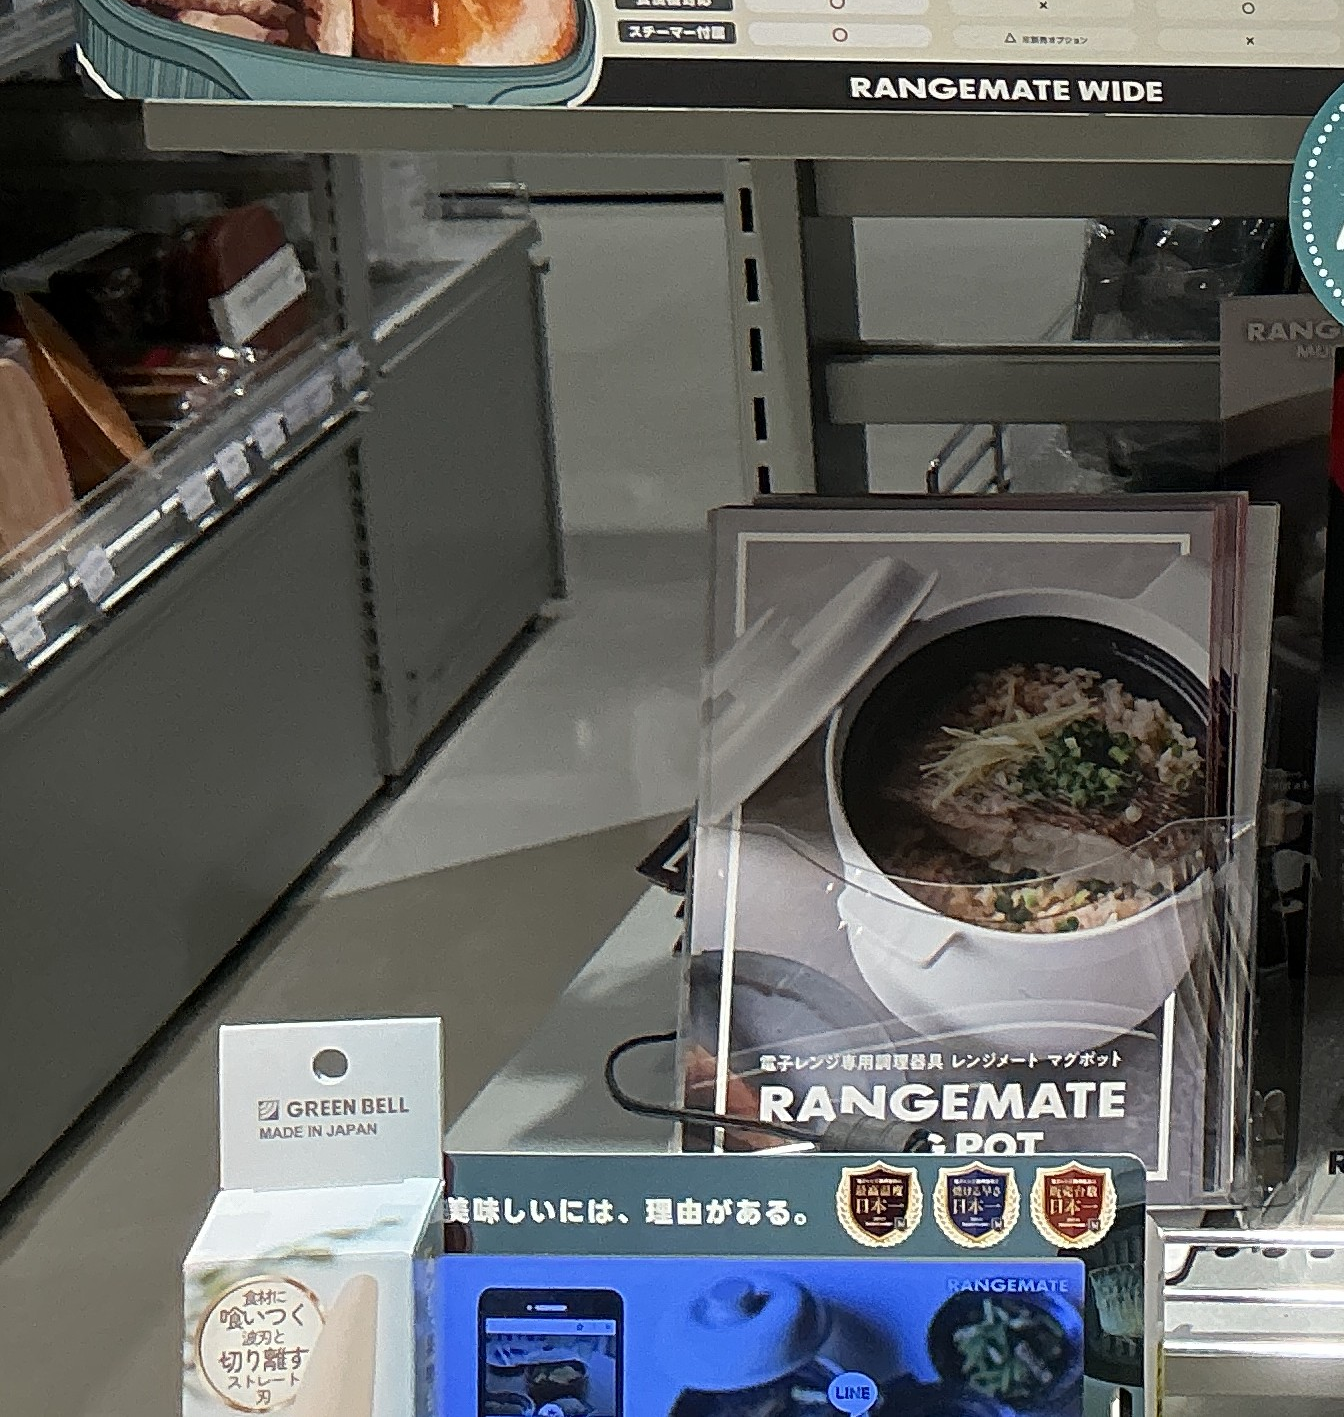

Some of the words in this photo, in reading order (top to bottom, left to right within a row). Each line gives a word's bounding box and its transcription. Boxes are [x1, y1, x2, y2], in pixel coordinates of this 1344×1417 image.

[849, 76, 1072, 102] RANGEMATE
[1077, 80, 1165, 103] WIDE
[759, 1053, 944, 1071] 電子レンジ専用調理器具
[951, 1052, 1039, 1069] レンジメート
[1046, 1050, 1123, 1069] マグポット
[286, 1098, 356, 1118] GREEN
[361, 1096, 410, 1116] BELL
[759, 1080, 1128, 1123] RANGEMATE
[259, 1125, 304, 1139] MADE
[307, 1124, 323, 1138] IN
[326, 1122, 378, 1138] JAPAN
[855, 1198, 905, 1215] 日本一
[952, 1198, 1002, 1215] 日本一
[1049, 1198, 1099, 1215] 日本一
[946, 1277, 1069, 1294] RANGEMATE
[242, 1289, 287, 1306] 食材に
[218, 1304, 305, 1330] 喰いつく
[218, 1347, 310, 1373] 切り離す
[228, 1372, 300, 1390] ストレート
[255, 1389, 272, 1405] 刃
[835, 1385, 871, 1402] LINE
